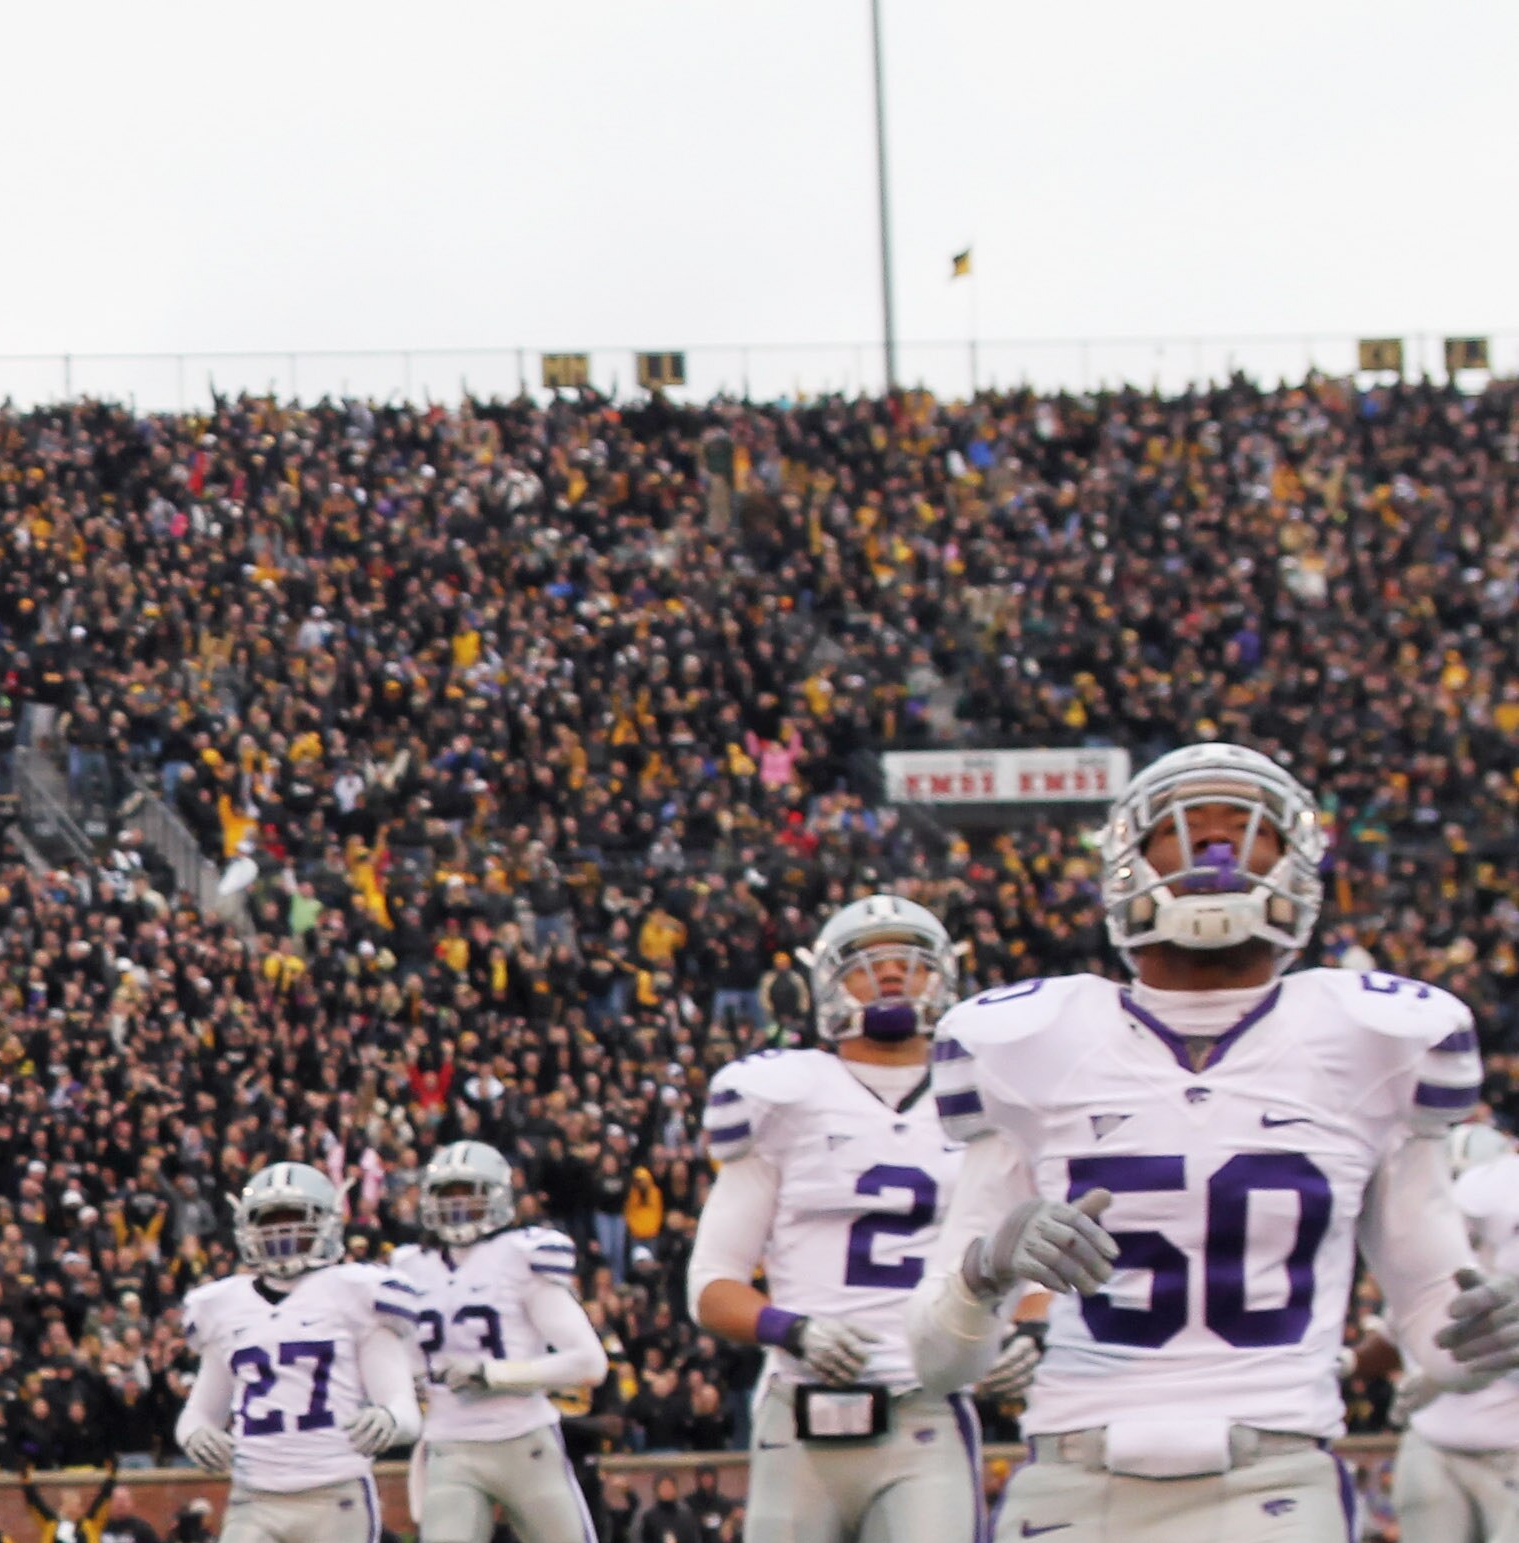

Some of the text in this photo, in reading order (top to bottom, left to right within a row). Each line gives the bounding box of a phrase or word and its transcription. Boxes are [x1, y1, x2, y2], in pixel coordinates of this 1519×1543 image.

[844, 1163, 938, 1290] 2
[1067, 1152, 1333, 1349] 50
[228, 1340, 336, 1437] 27
